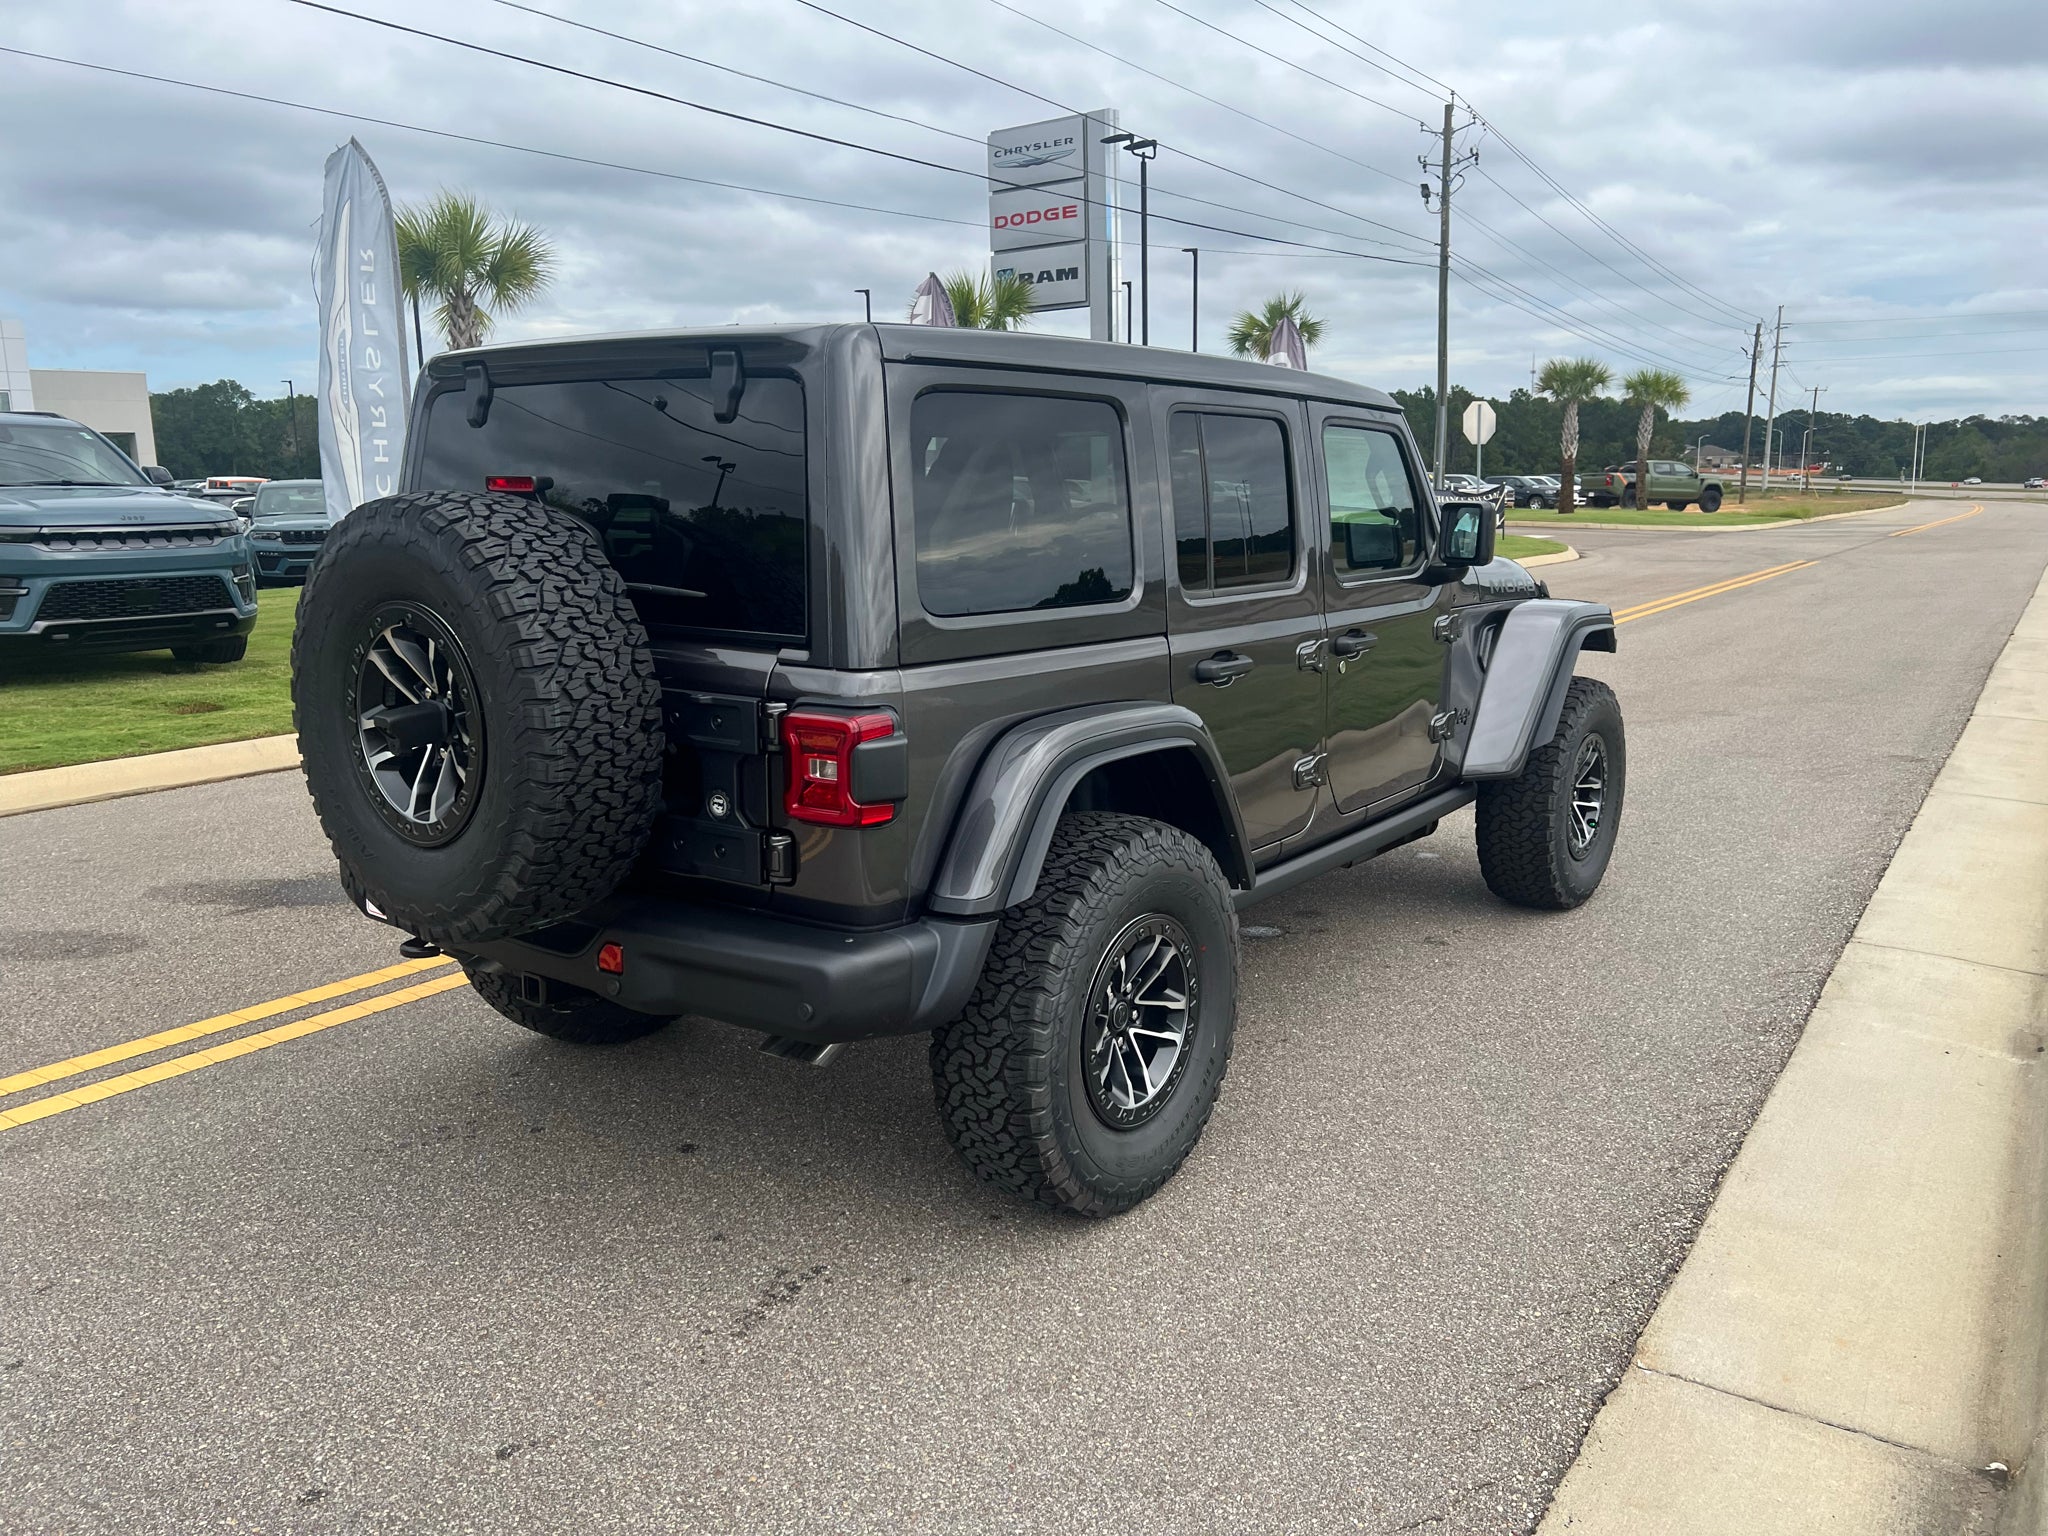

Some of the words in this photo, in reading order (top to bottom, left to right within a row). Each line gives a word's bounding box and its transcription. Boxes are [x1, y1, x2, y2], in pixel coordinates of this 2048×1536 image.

[994, 137, 1074, 158] CHRYSLER
[994, 205, 1078, 229] DODGE
[1018, 266, 1079, 284] RAM
